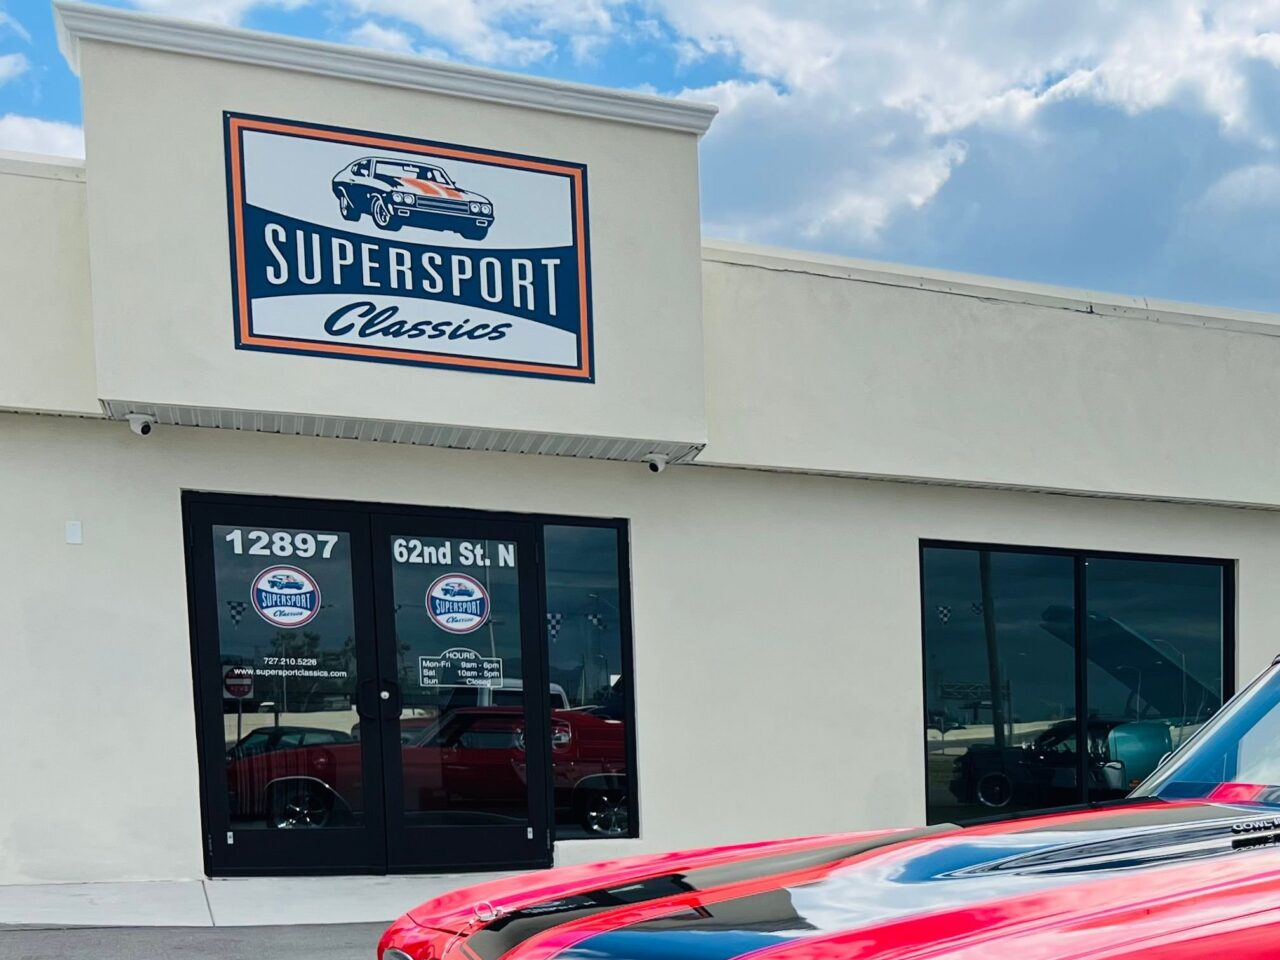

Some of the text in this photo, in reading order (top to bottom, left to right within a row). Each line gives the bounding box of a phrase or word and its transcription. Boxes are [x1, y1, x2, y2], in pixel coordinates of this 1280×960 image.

[264, 223, 560, 316] SUPERSPORT
[324, 301, 512, 341] Classics
[226, 529, 338, 558] 12897
[393, 539, 515, 567] 62nd St. N
[262, 591, 310, 609] SUPERSPORT
[435, 599, 480, 616] SUPERSPORT
[233, 668, 347, 677] www.supersportclassics.com
[1232, 821, 1273, 832] COWL
